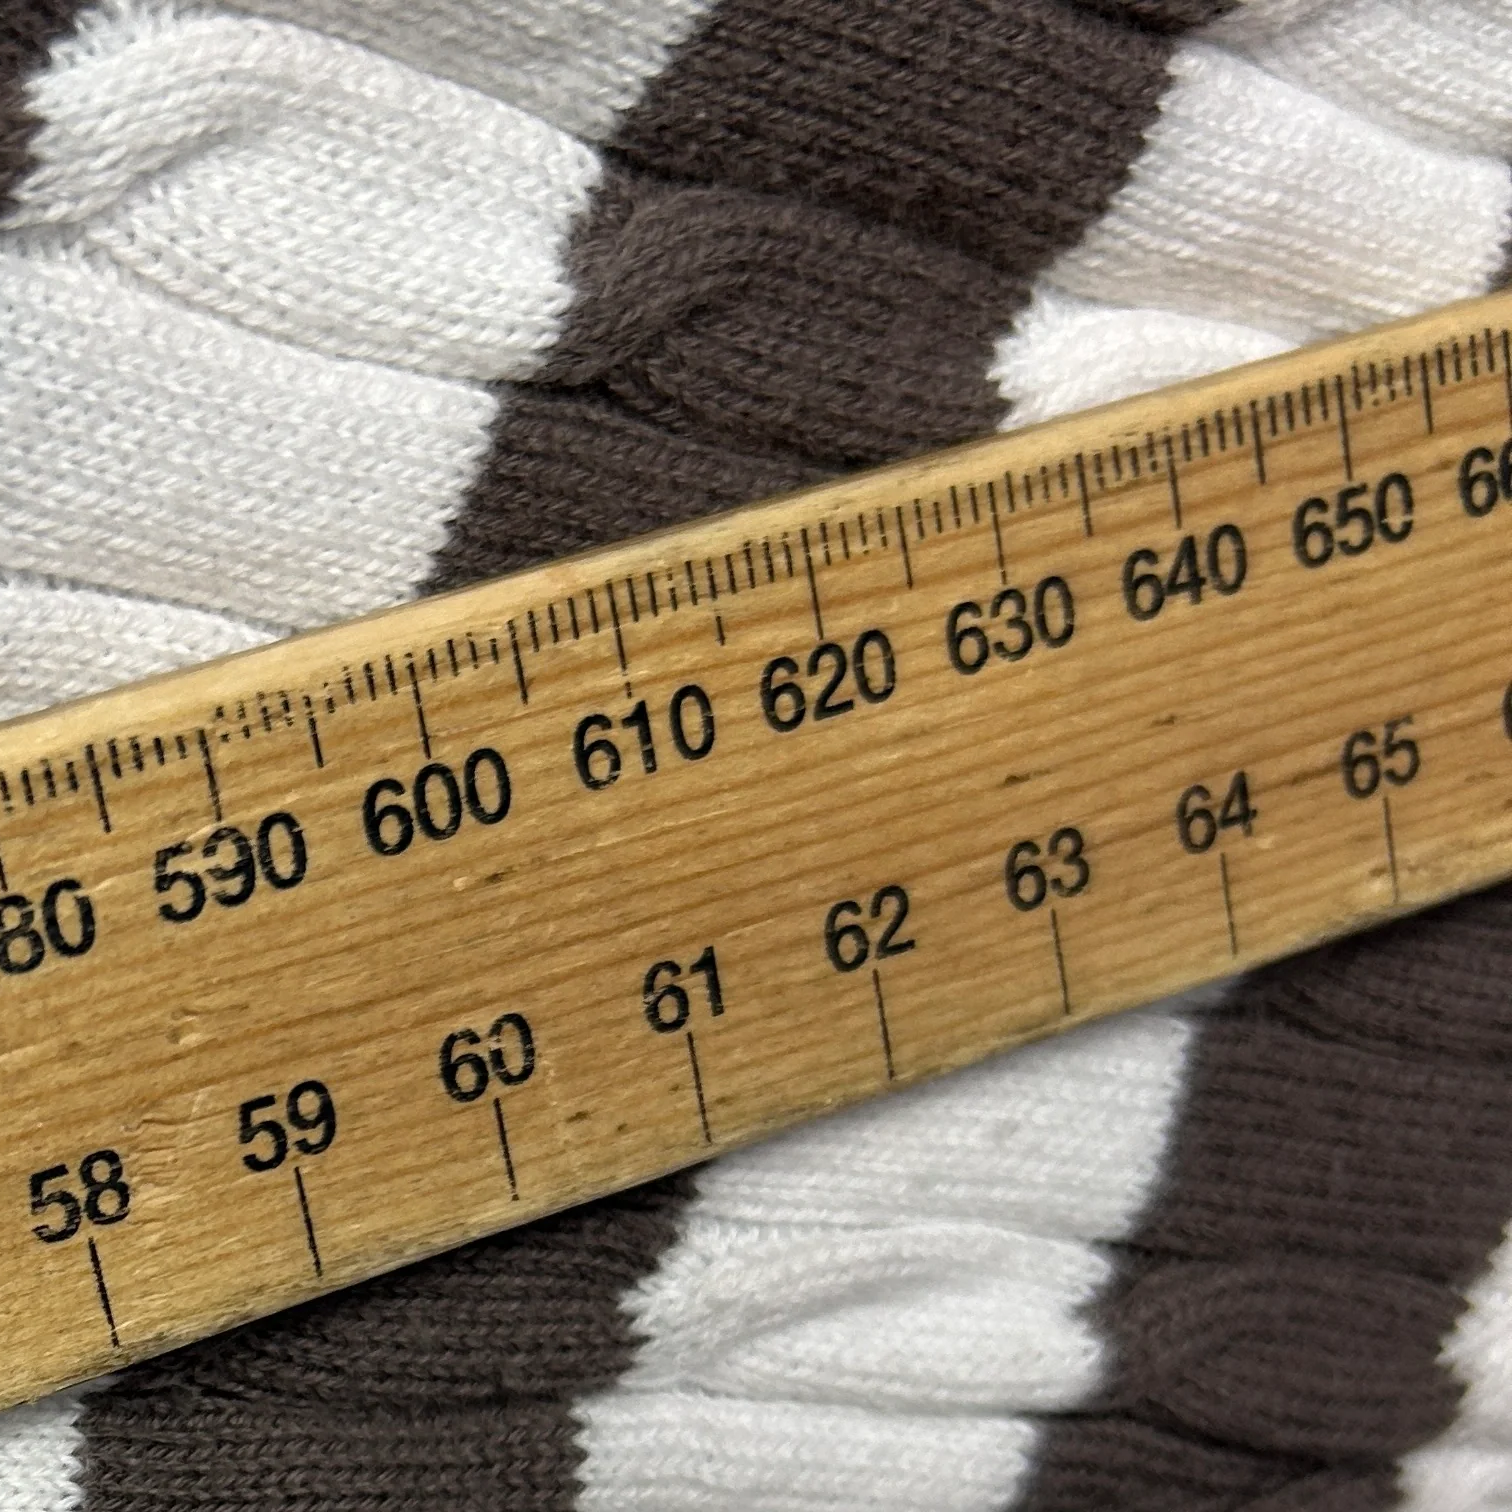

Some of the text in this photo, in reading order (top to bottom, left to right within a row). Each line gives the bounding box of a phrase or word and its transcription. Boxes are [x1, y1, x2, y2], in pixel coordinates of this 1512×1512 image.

[154, 811, 308, 924] 590
[362, 747, 512, 856] 600
[573, 685, 715, 791] 610
[759, 628, 897, 732] 620
[946, 575, 1076, 675] 630
[1122, 523, 1248, 619] 640
[1293, 473, 1415, 568] 650
[28, 1149, 132, 1243] 58
[238, 1080, 337, 1172] 59
[439, 1013, 536, 1103] 60
[642, 945, 724, 1034] 61
[824, 881, 917, 973] 62
[1002, 826, 1090, 912] 63
[1175, 770, 1260, 854] 64
[1340, 715, 1422, 799] 65
